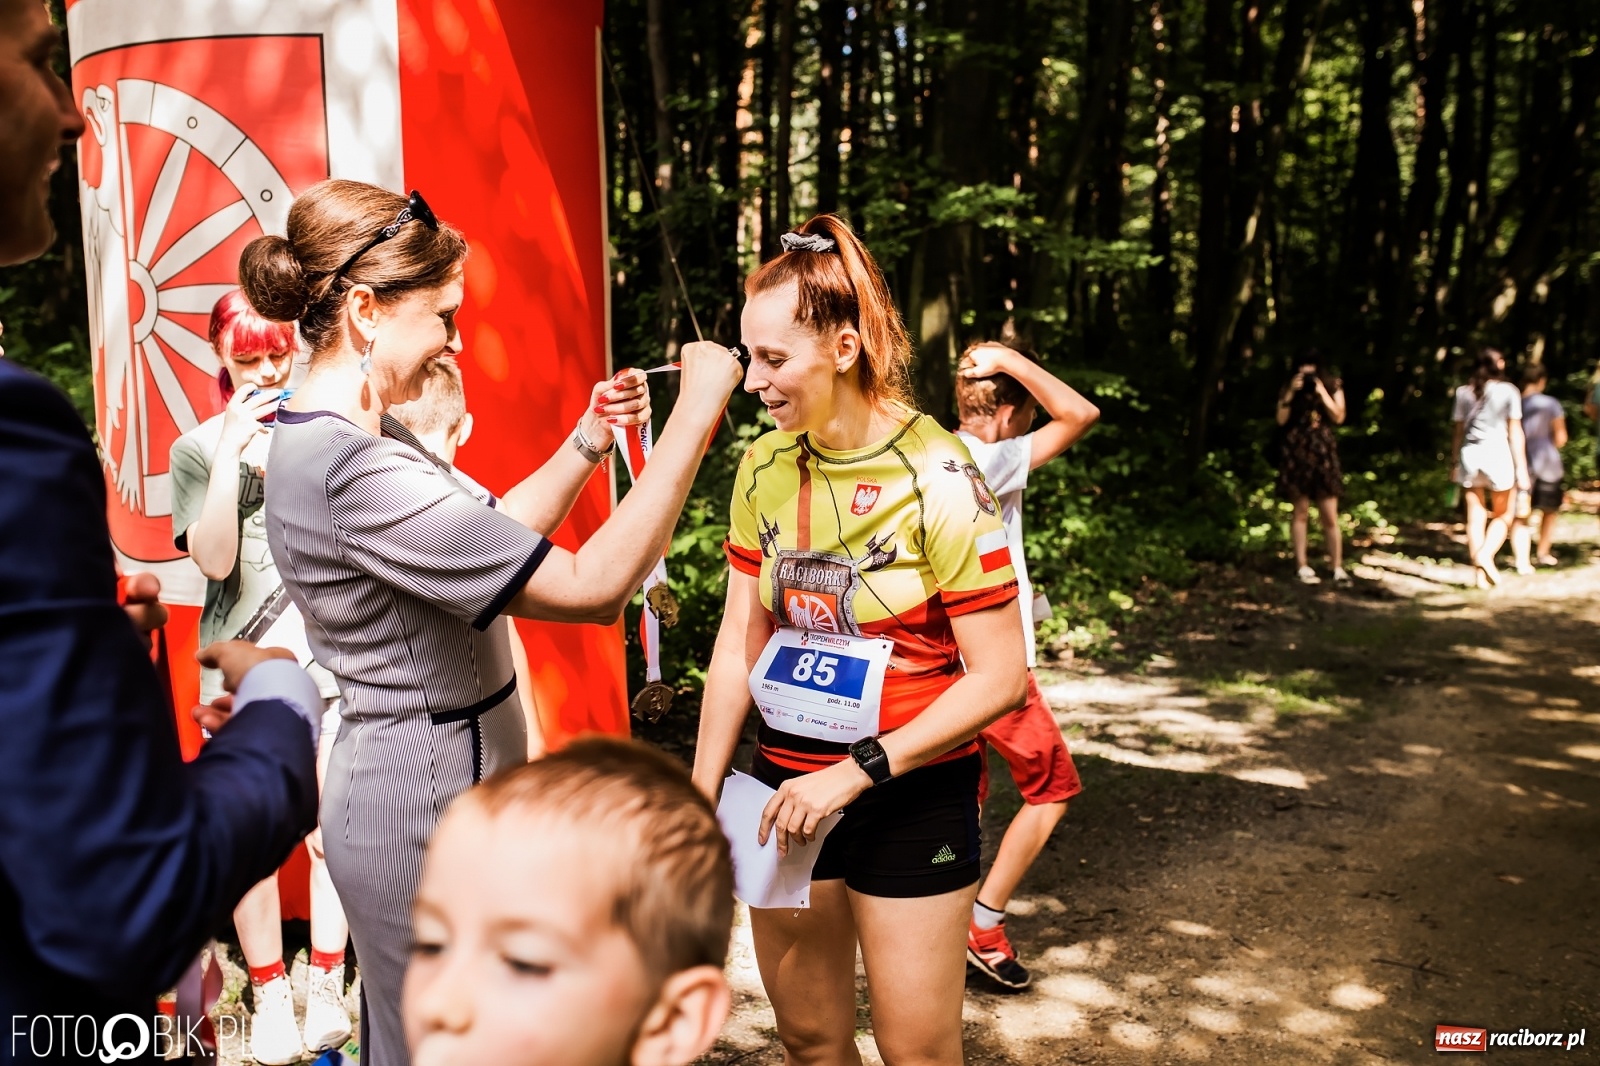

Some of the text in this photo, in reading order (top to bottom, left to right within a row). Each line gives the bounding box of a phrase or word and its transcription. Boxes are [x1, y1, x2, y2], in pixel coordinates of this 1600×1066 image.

[640, 421, 648, 452] PGNiG
[856, 476, 878, 484] POLSKA
[792, 653, 839, 687] 85
[761, 683, 773, 691] 1963
[827, 697, 860, 709] godz. 11.00
[932, 854, 955, 863] adidas
